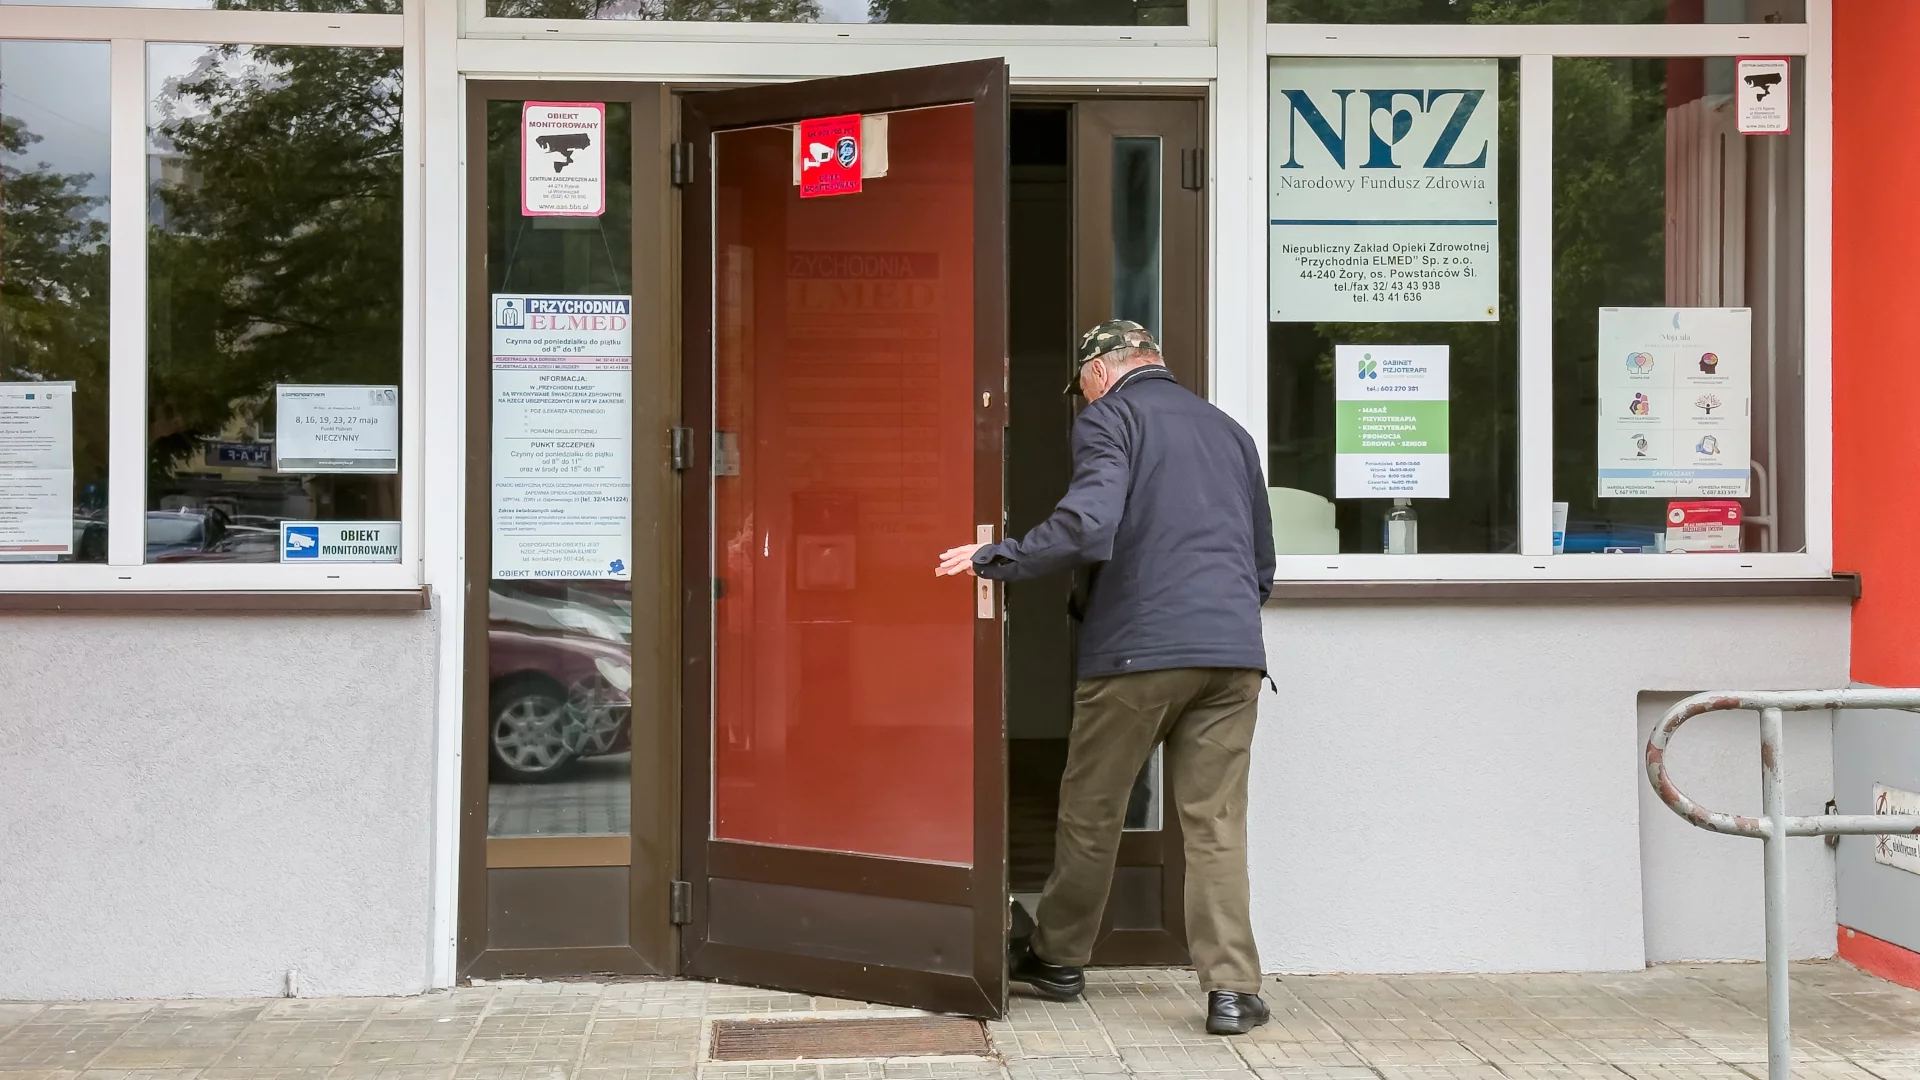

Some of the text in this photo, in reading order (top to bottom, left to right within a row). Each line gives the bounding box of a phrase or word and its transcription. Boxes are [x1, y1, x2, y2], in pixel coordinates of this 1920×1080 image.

[1280, 89, 1488, 170] NFZ
[1280, 175, 1485, 193] Narodowy Fundusz Zdrowia
[1282, 242, 1490, 255] Niepubliczny Zakład Opieki Zdrowotnej
[1421, 255, 1440, 267] Sp.
[1452, 257, 1473, 265] o.o.
[1300, 267, 1477, 281] 44-240 Żory, os. Powstańców Śl.
[1334, 281, 1441, 292] tel./fax 32/ 43 43 938
[1353, 292, 1422, 302] tel. 43 41 636
[530, 300, 625, 314] PRZYCHODNIA
[530, 315, 627, 331] ELMED
[544, 338, 588, 346] poniedziałku
[1660, 333, 1677, 342] Moja
[295, 416, 378, 425] 8, 16, 19, 23, 27 maja
[315, 434, 359, 442] NIECZYNNY
[594, 451, 614, 459] piątku
[541, 466, 559, 474] środy
[341, 530, 380, 541] OBIEKT
[322, 546, 398, 555] MONITOROWANY
